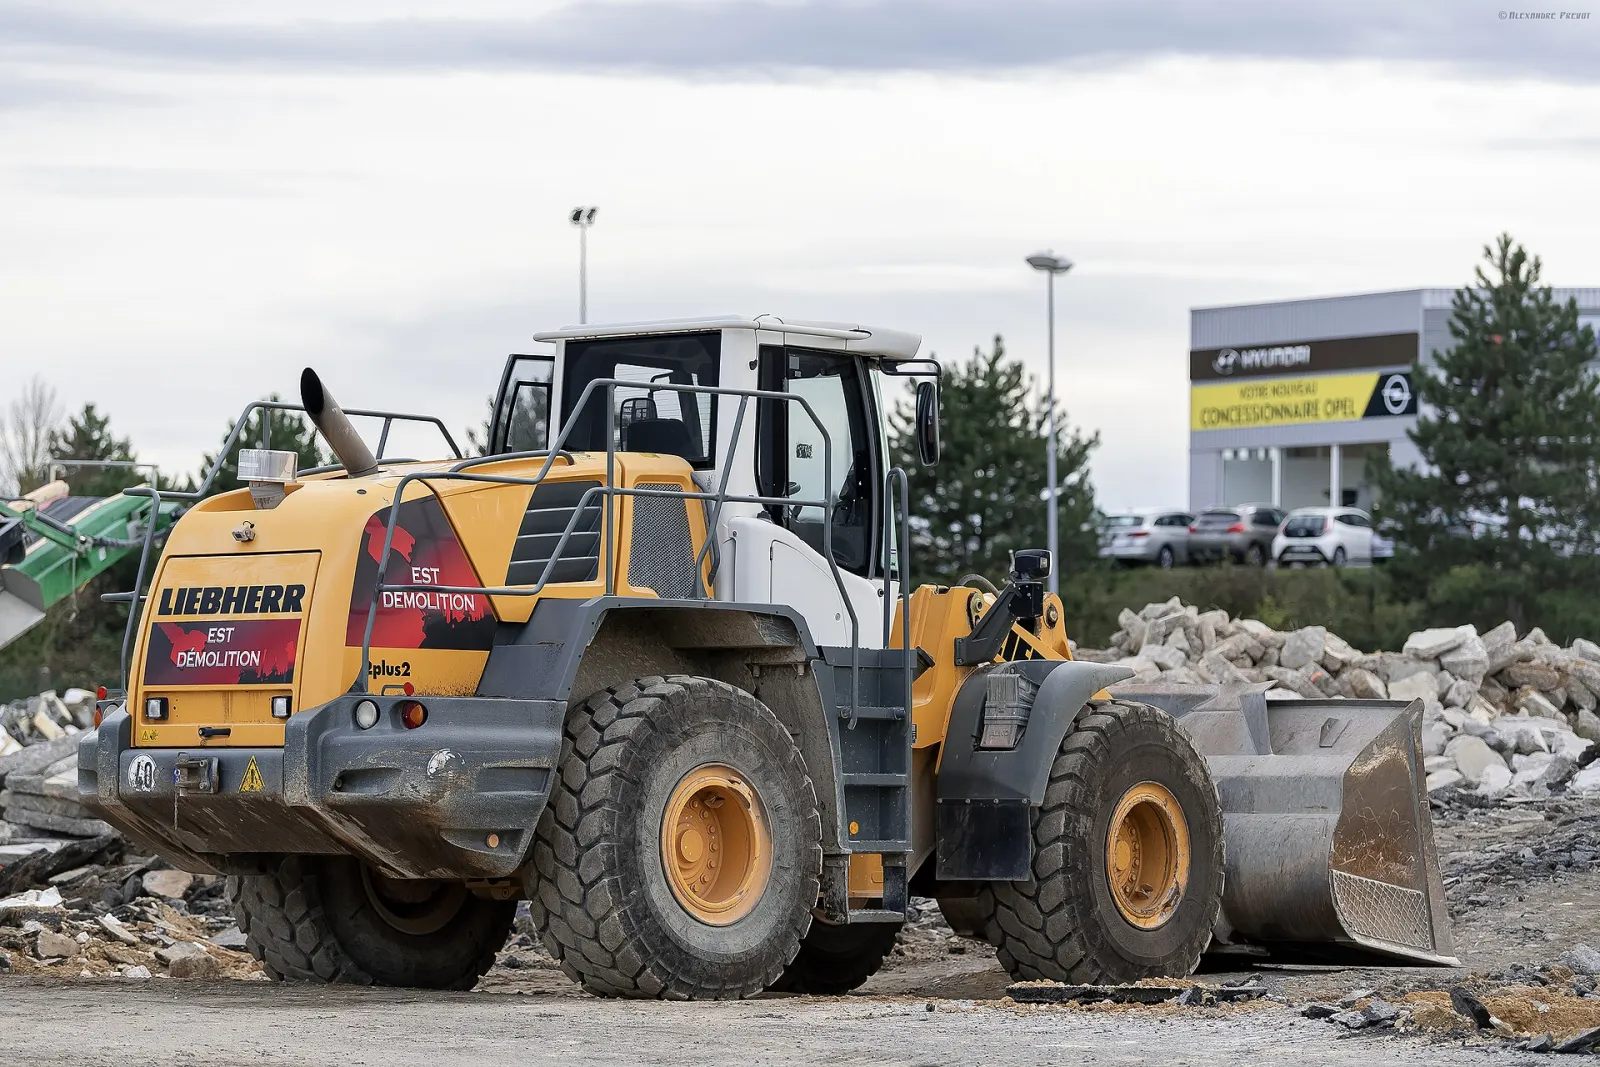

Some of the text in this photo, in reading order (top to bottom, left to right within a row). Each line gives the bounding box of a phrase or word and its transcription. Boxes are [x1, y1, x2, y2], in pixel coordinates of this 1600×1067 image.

[1241, 345, 1311, 369] HYUNDAI
[1239, 384, 1269, 398] VOTRE
[1201, 398, 1356, 426] CONCESSIONNAIRE OPEL
[411, 566, 440, 585] EST
[157, 584, 306, 616] LIEBHERR
[207, 626, 235, 644] EST
[176, 647, 261, 668] DÉMOLITION
